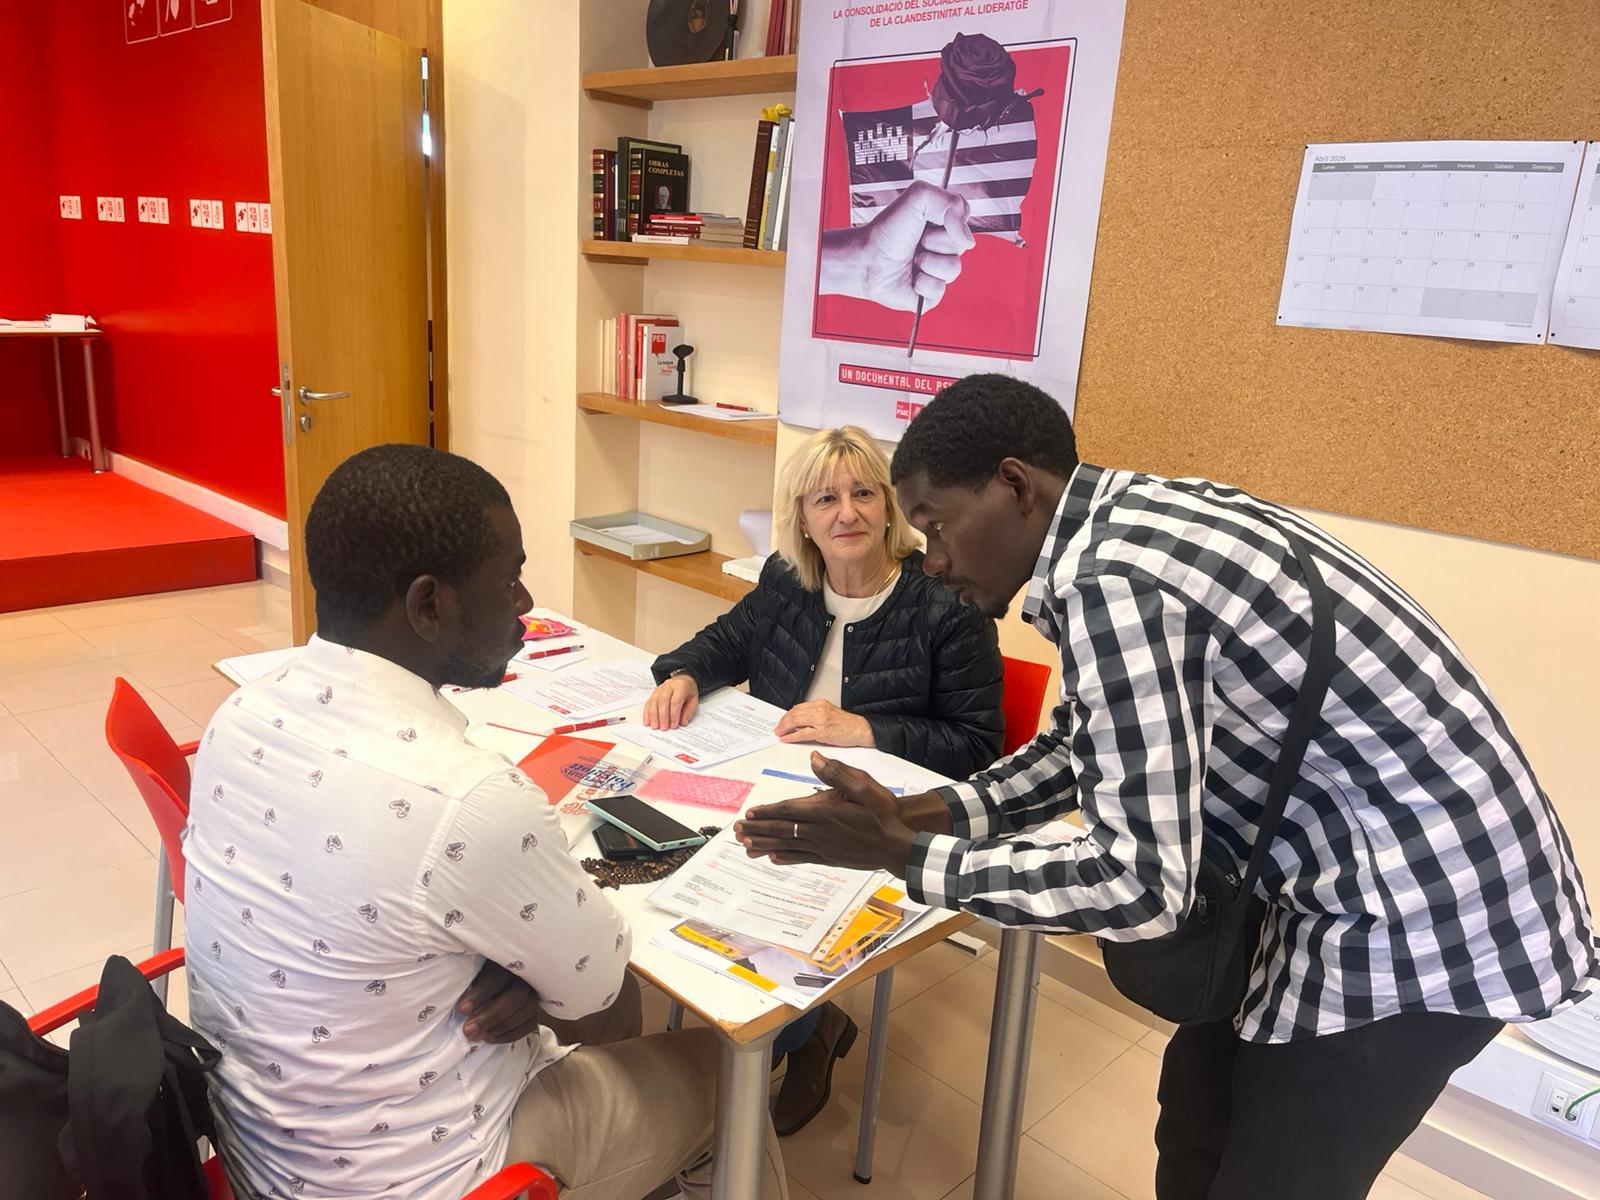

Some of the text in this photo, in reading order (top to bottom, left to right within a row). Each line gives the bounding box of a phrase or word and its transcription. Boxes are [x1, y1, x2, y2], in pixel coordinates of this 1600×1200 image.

[833, 10, 843, 19] LA
[904, 0, 920, 10] DEL
[870, 0, 1029, 27] DE LA CLANDESTINITAT AL LIDERATGE
[648, 160, 669, 168] OBRAS
[648, 166, 684, 177] COMPLETAS
[652, 334, 666, 342] PES
[841, 368, 853, 380] UN
[855, 370, 911, 388] DOCUMENTAL
[914, 379, 932, 391] DEL
